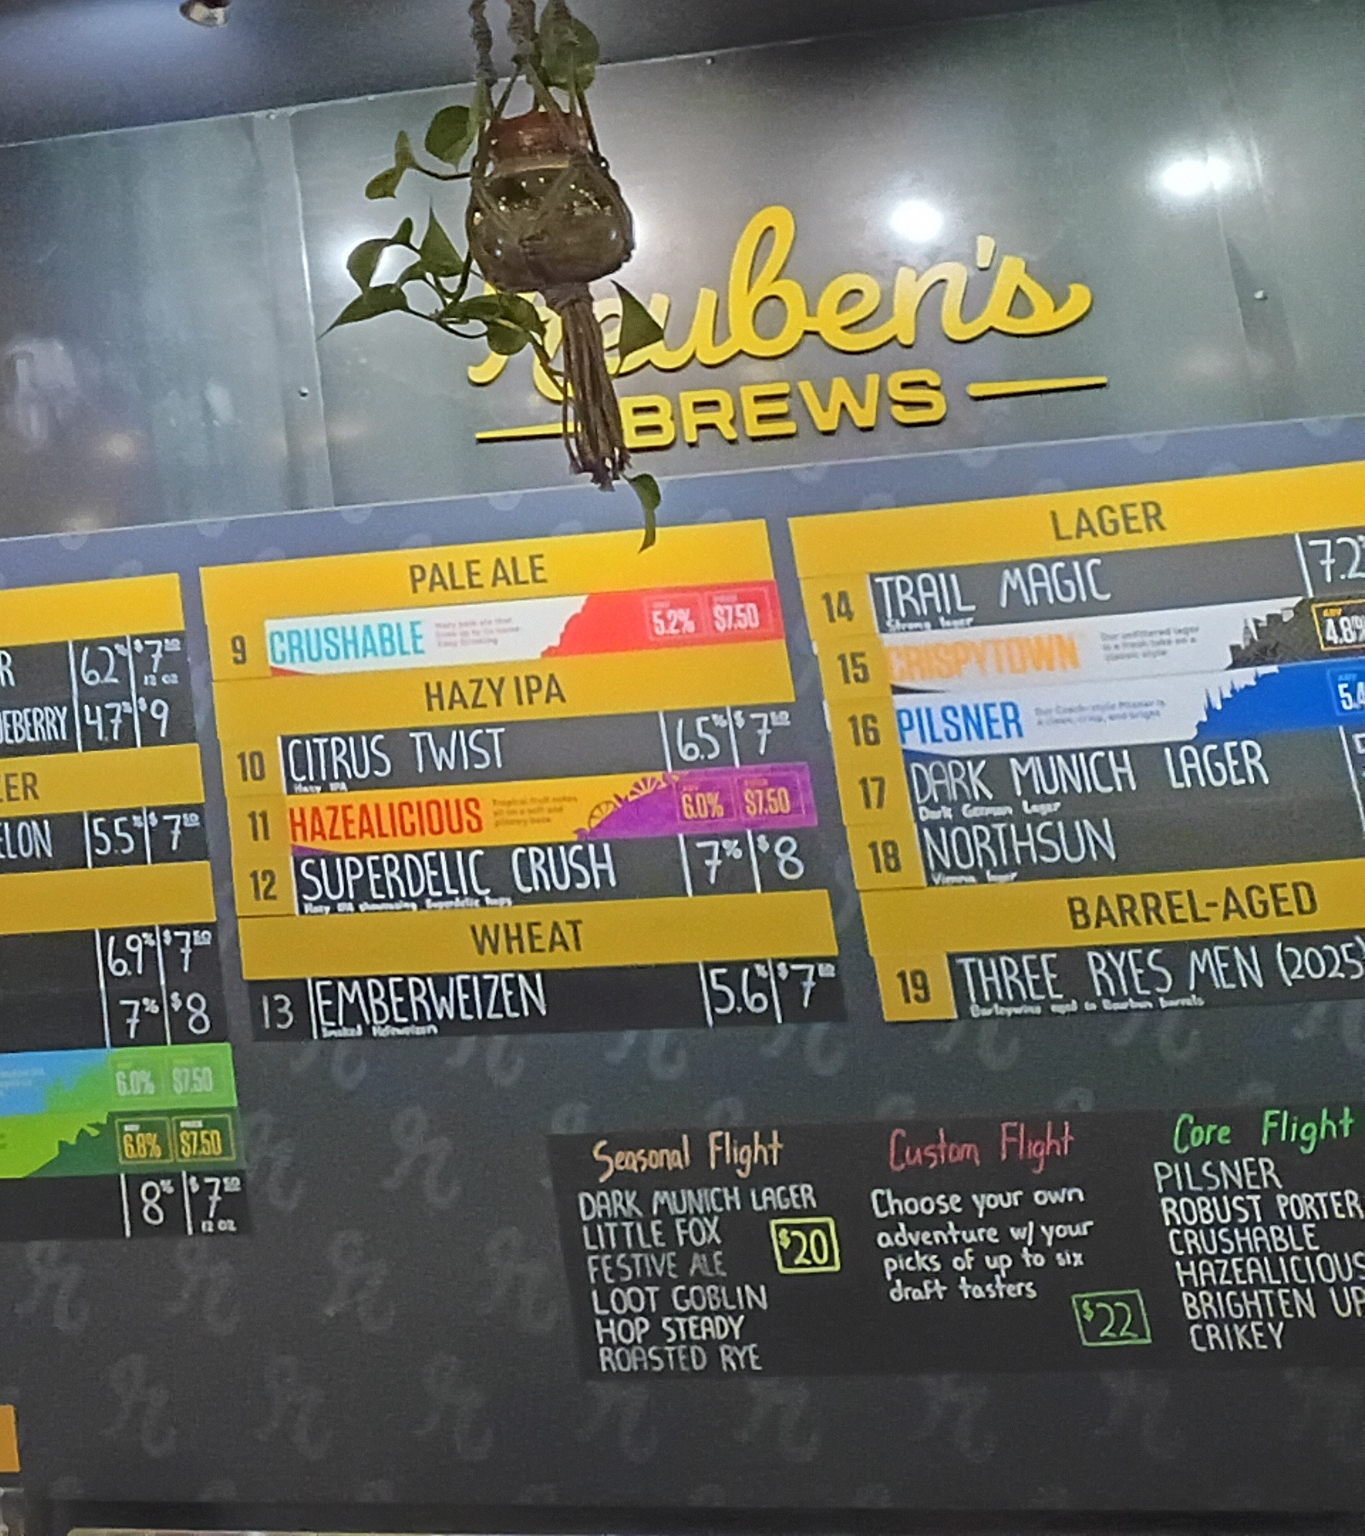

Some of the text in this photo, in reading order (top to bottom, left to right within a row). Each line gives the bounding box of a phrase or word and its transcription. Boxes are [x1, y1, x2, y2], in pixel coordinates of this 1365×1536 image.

[624, 369, 947, 450] BREWS
[1050, 500, 1167, 542] LAGER
[409, 553, 549, 594] PALE ALE
[821, 534, 1365, 624] 14 TRAIL MAGIC 7.2
[230, 635, 247, 665] 9
[269, 620, 426, 665] CRUSHABLE
[652, 607, 696, 636] 5.2%
[713, 602, 760, 633] $7.50
[837, 651, 870, 685] 15
[889, 633, 1081, 683] CRISPYTOWN
[424, 672, 567, 712] HAZY IPA
[847, 714, 881, 747] 16
[896, 700, 1025, 745] PILSNER
[237, 750, 266, 782] 10
[287, 734, 392, 782] CITRUS
[409, 727, 506, 774] TWIST
[858, 739, 1269, 810] 17 DARK MUNICH LAGER
[248, 810, 270, 842] 11
[288, 797, 484, 843] HAZEALICIOUS
[681, 790, 725, 821] 6.0%
[743, 786, 791, 817] $7.50
[867, 817, 1117, 875] 18 NORTHSUN
[249, 869, 278, 902] 12
[300, 850, 491, 902] SUPERDELIC
[511, 842, 617, 894] CRUSH
[1066, 880, 1319, 931] BARREL-AGED
[470, 919, 583, 956] WHEAT
[896, 968, 932, 1005] 19
[954, 952, 1065, 1004] THREE
[1086, 948, 1174, 998] RYES
[1188, 944, 1265, 992] MEN
[170, 991, 211, 1035] $8
[261, 993, 295, 1030] 13
[315, 972, 547, 1028] EMBERWEIZEN
[179, 1129, 223, 1158] $7.50
[888, 1120, 1075, 1174] Custom Flight
[1173, 1106, 1355, 1155] Core Flight
[592, 1129, 784, 1183] Seasonal Flight
[1153, 1157, 1284, 1194] PILSNER
[577, 1183, 817, 1221] DARK MUNICH LAGER
[870, 1186, 1085, 1219] Choose your own
[1161, 1189, 1365, 1227] ROBUST PORTER
[582, 1216, 829, 1266] LITTLE FOX $20
[876, 1220, 1094, 1249] adventure w/ your
[1168, 1223, 1320, 1256] CRUSHABLE
[587, 1251, 728, 1284] FESTIVE ALE
[883, 1246, 1085, 1282] picks of up to six
[1175, 1252, 1365, 1288] HAZEALICIOUS
[591, 1284, 768, 1316] LOOT GOBLIN
[888, 1274, 1139, 1339] draft tasters $22
[1182, 1286, 1365, 1320] BRIGHTEN UP
[595, 1314, 745, 1344] HOP STEADY
[1190, 1321, 1285, 1352] CRIKEY
[599, 1343, 763, 1373] ROASTED RYE
